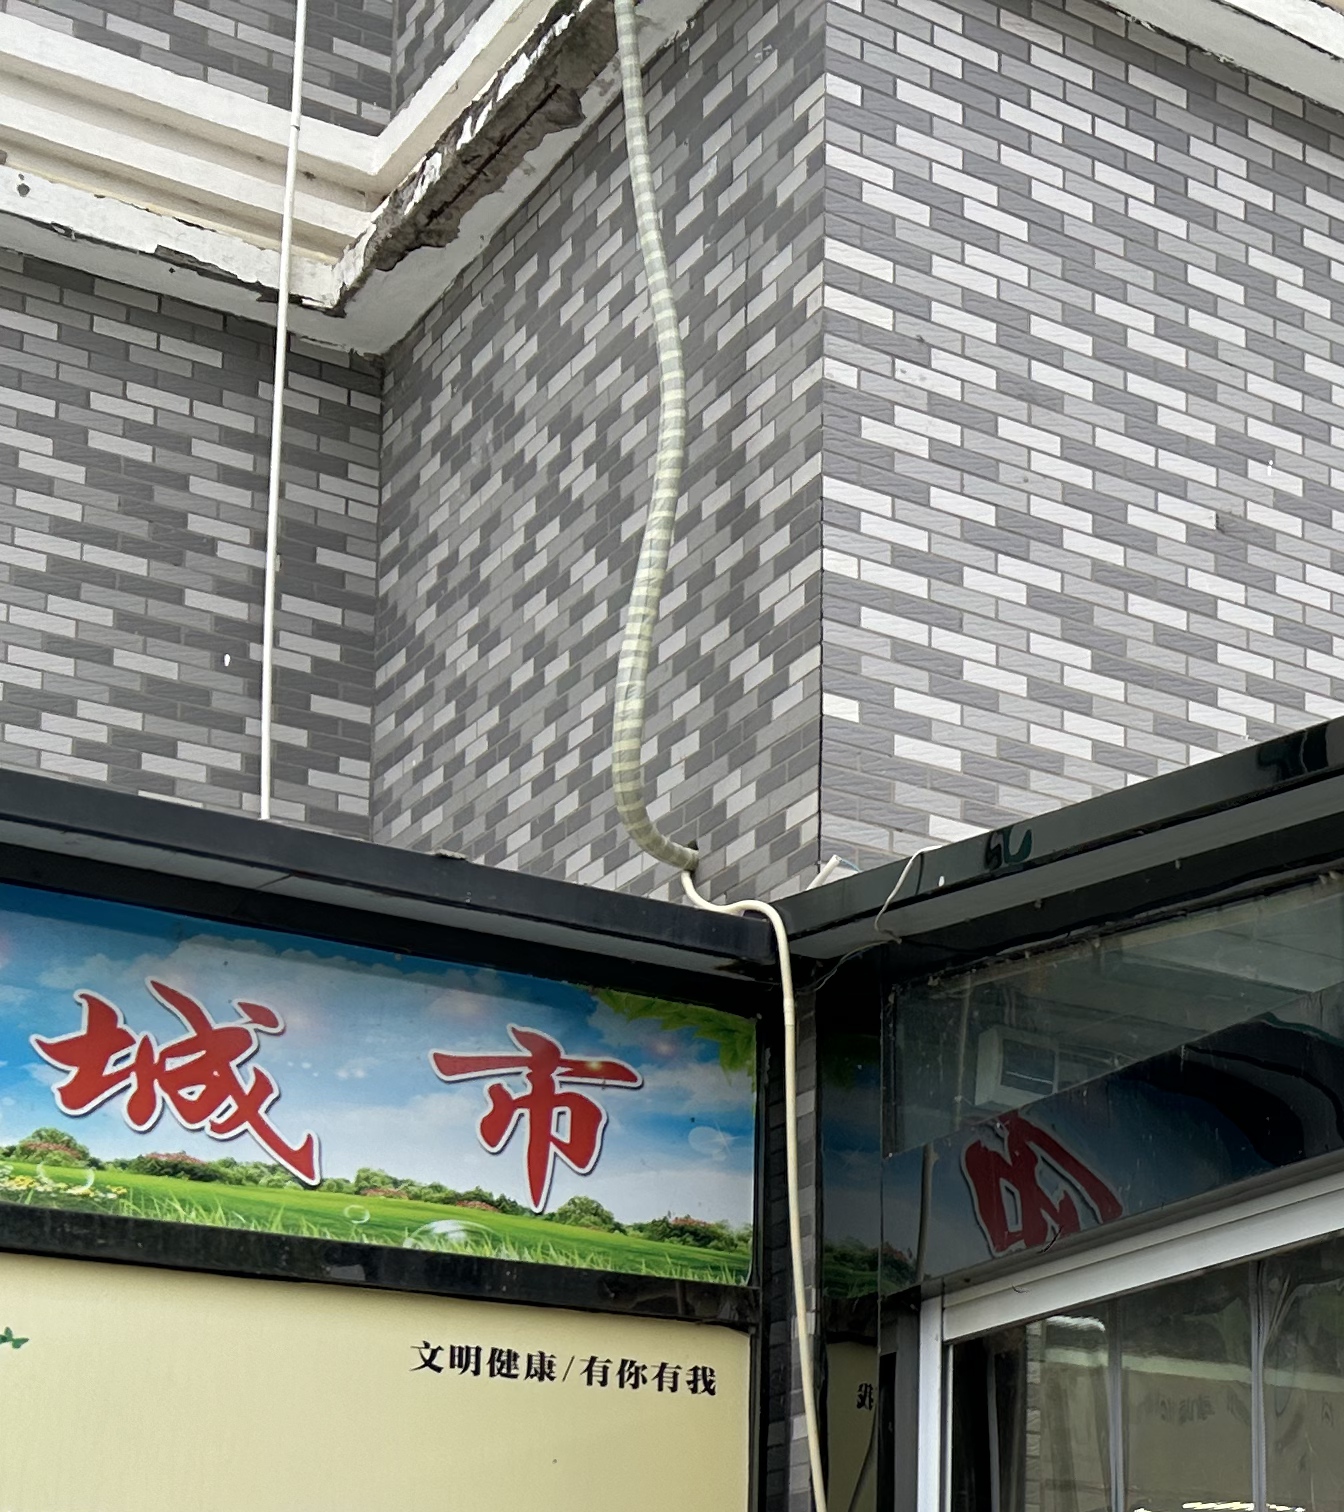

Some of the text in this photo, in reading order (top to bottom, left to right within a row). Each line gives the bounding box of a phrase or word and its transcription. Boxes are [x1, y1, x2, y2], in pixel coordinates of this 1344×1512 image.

[32, 976, 645, 1213] 城市
[410, 1340, 718, 1398] 文明健康/有你有我
